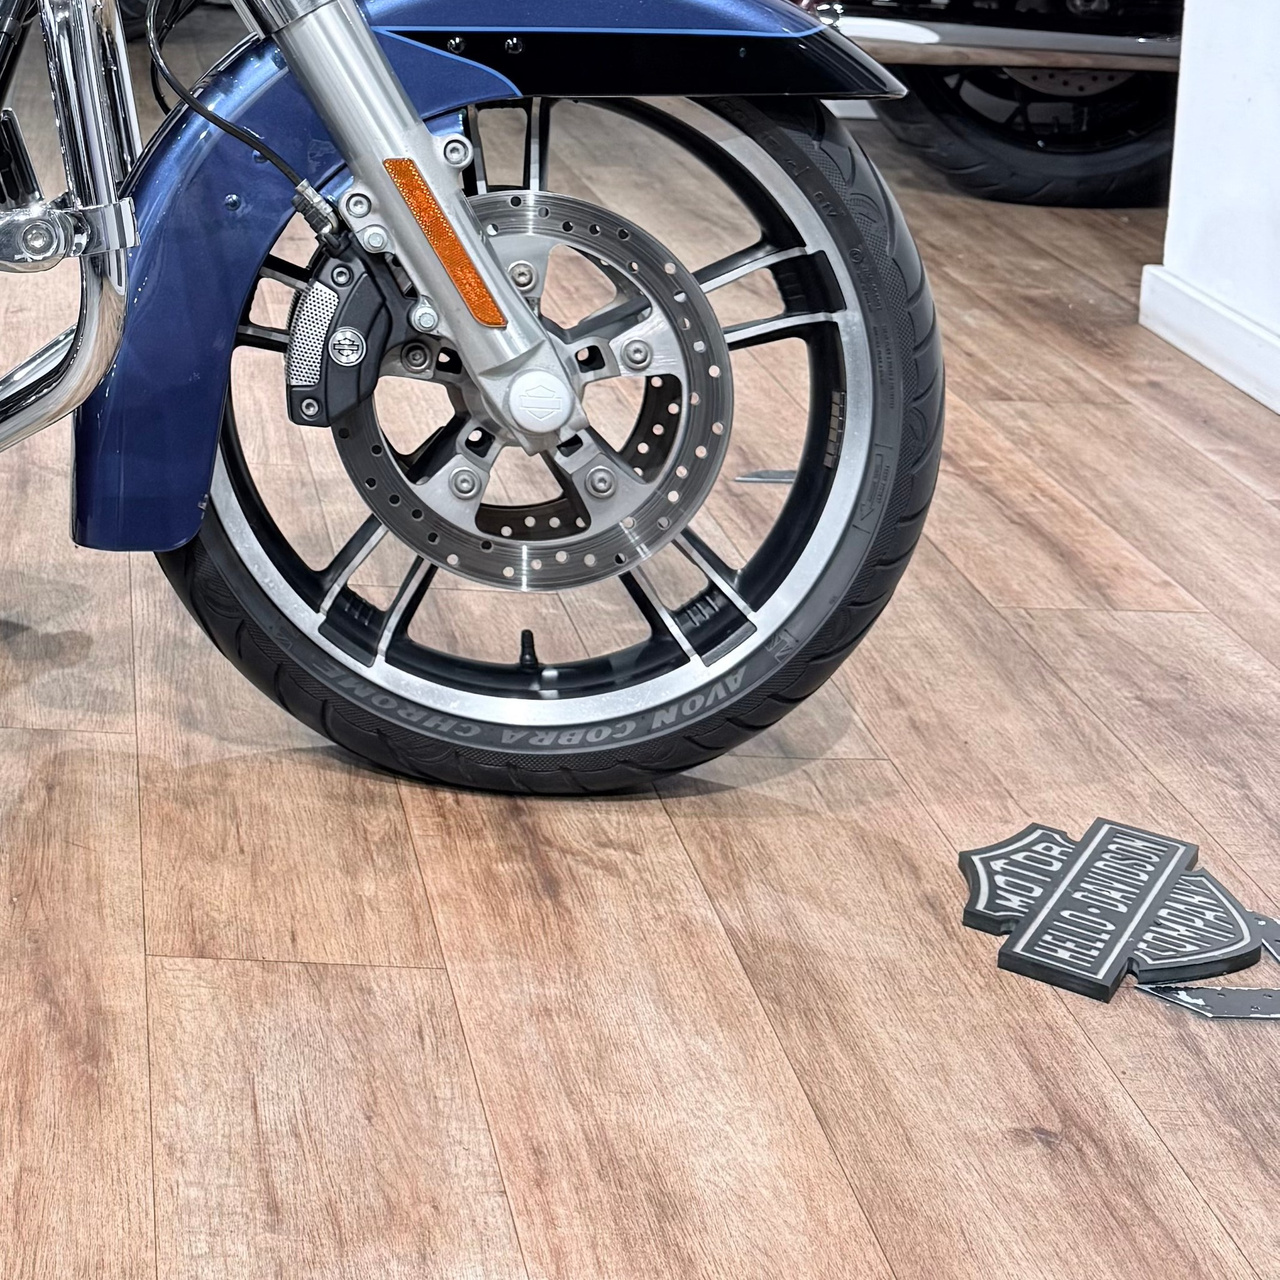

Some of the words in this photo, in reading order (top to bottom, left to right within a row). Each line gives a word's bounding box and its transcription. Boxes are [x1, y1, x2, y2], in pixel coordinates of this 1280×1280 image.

[312, 661, 481, 737] CHROME
[651, 666, 746, 729] AVON
[501, 720, 636, 746] COBRA
[990, 842, 1074, 912] MOTOR
[1072, 832, 1170, 913] DAVIDSON
[1033, 910, 1116, 967] HELLO
[1135, 874, 1235, 956] COMPANY
